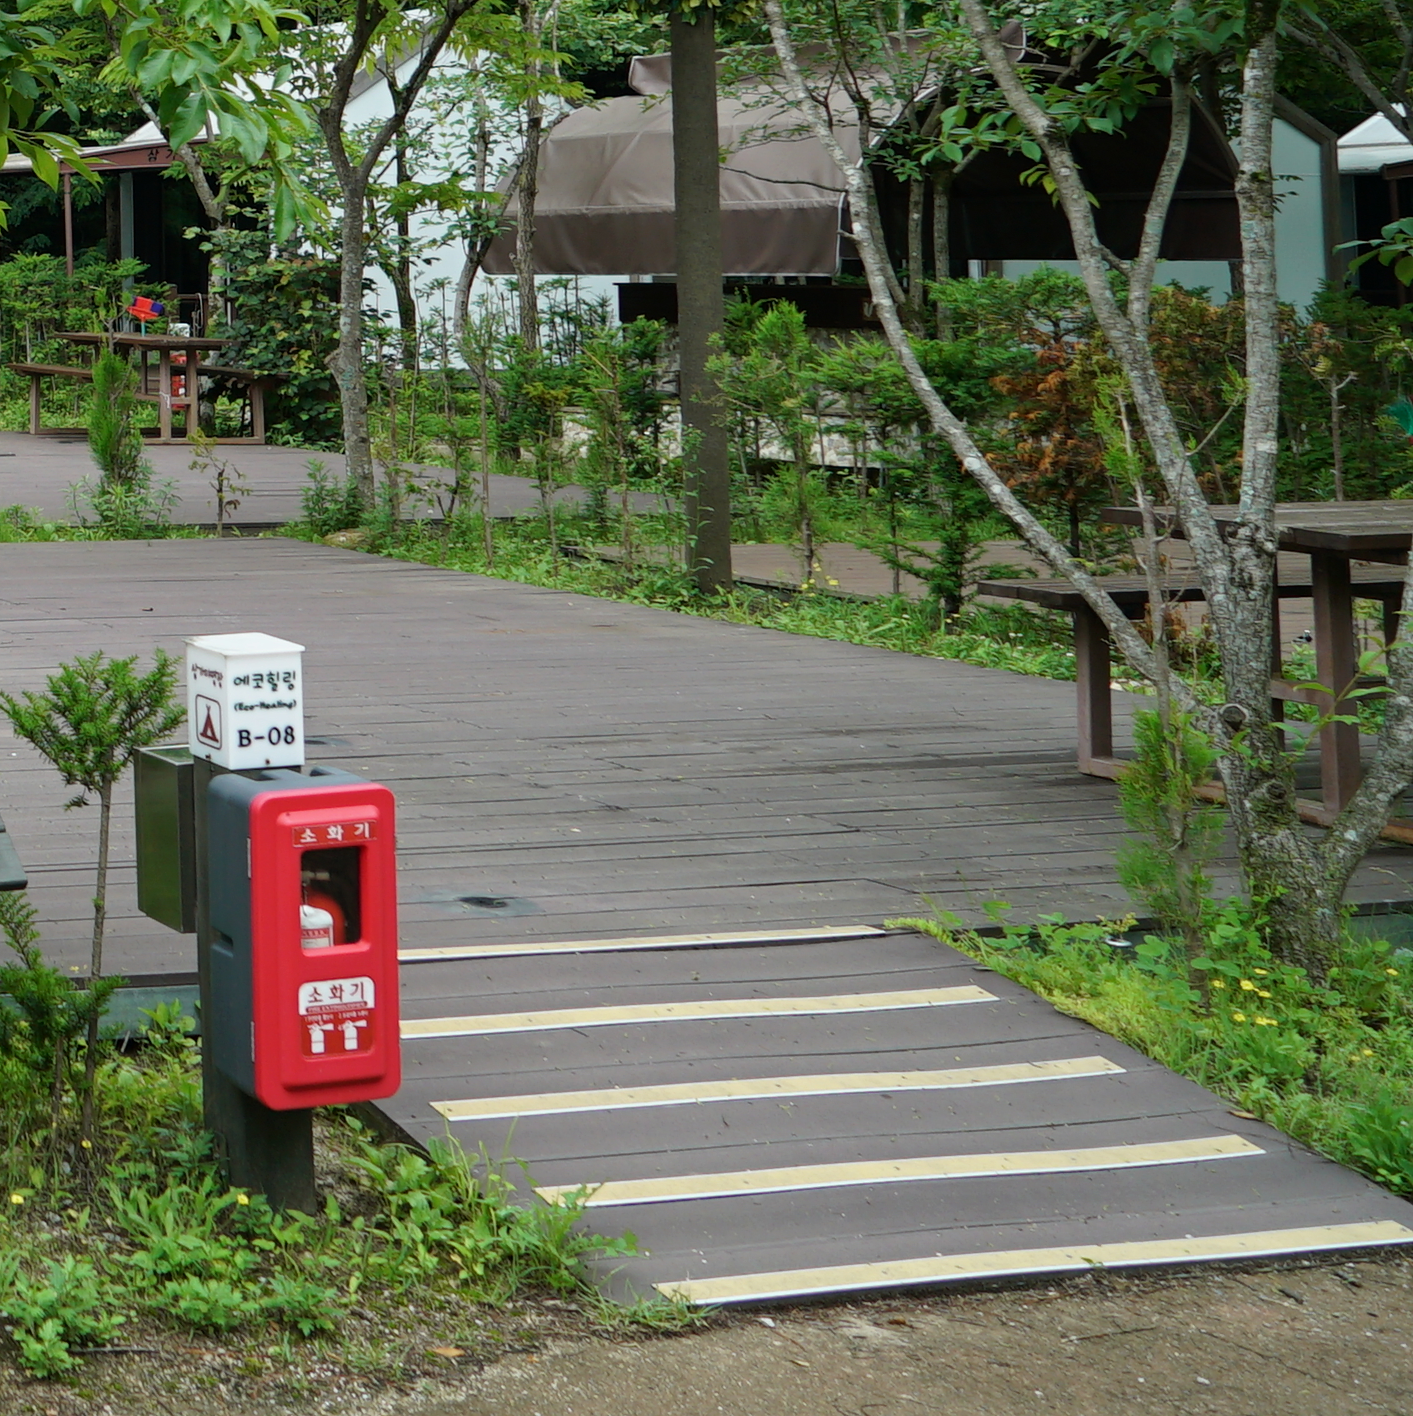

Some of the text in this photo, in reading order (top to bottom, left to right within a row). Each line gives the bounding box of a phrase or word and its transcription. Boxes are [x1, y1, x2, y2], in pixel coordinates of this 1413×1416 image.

[233, 670, 296, 692] 에코힐링
[237, 725, 295, 748] B-08
[308, 981, 364, 1004] 소화기
